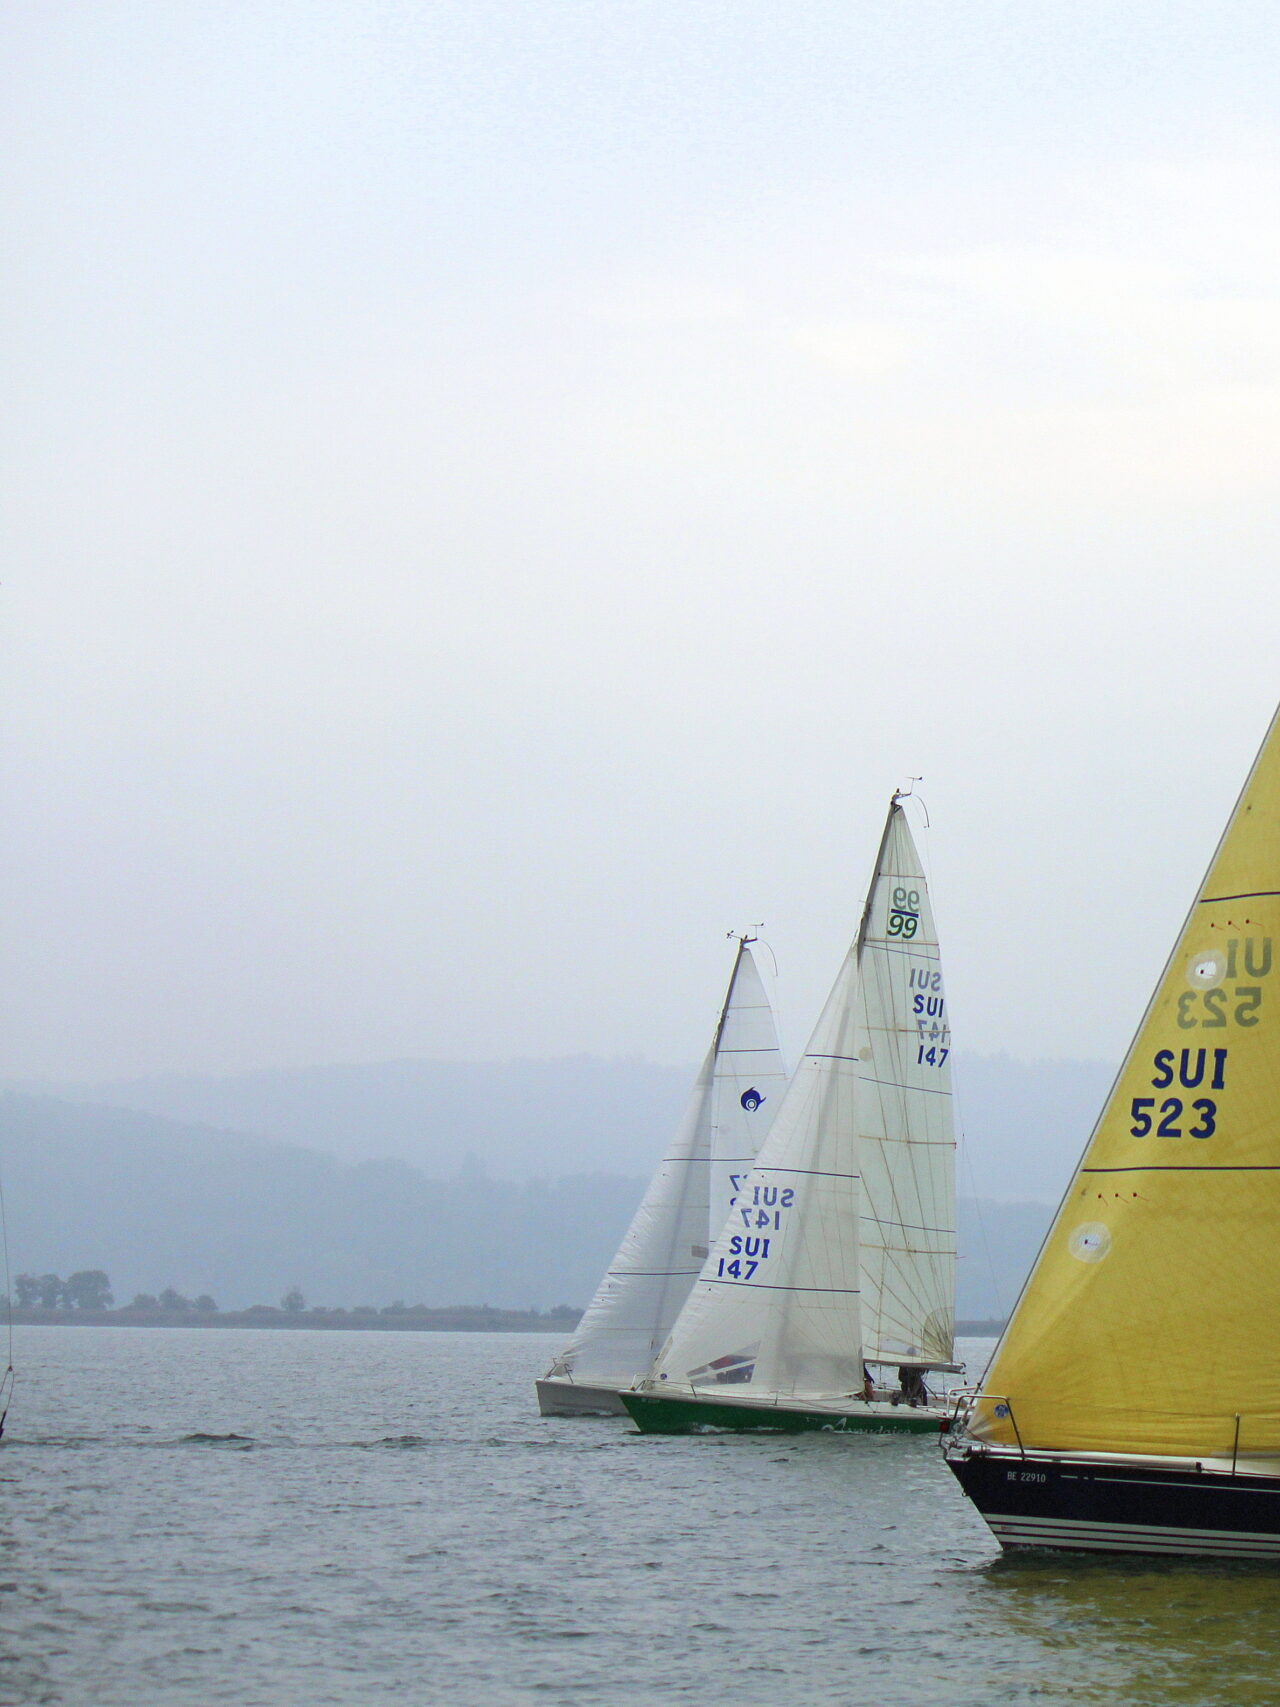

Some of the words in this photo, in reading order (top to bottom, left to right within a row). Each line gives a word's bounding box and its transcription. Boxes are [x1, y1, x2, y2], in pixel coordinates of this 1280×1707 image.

[887, 914, 918, 939] 99
[912, 994, 944, 1018] SUI
[917, 1045, 949, 1068] 147
[1151, 1048, 1228, 1090] SUI
[1130, 1097, 1217, 1139] 523
[729, 1235, 770, 1258] SUI
[717, 1258, 759, 1280] 147
[1007, 1471, 1017, 1481] BE
[1020, 1471, 1046, 1483] 22910
